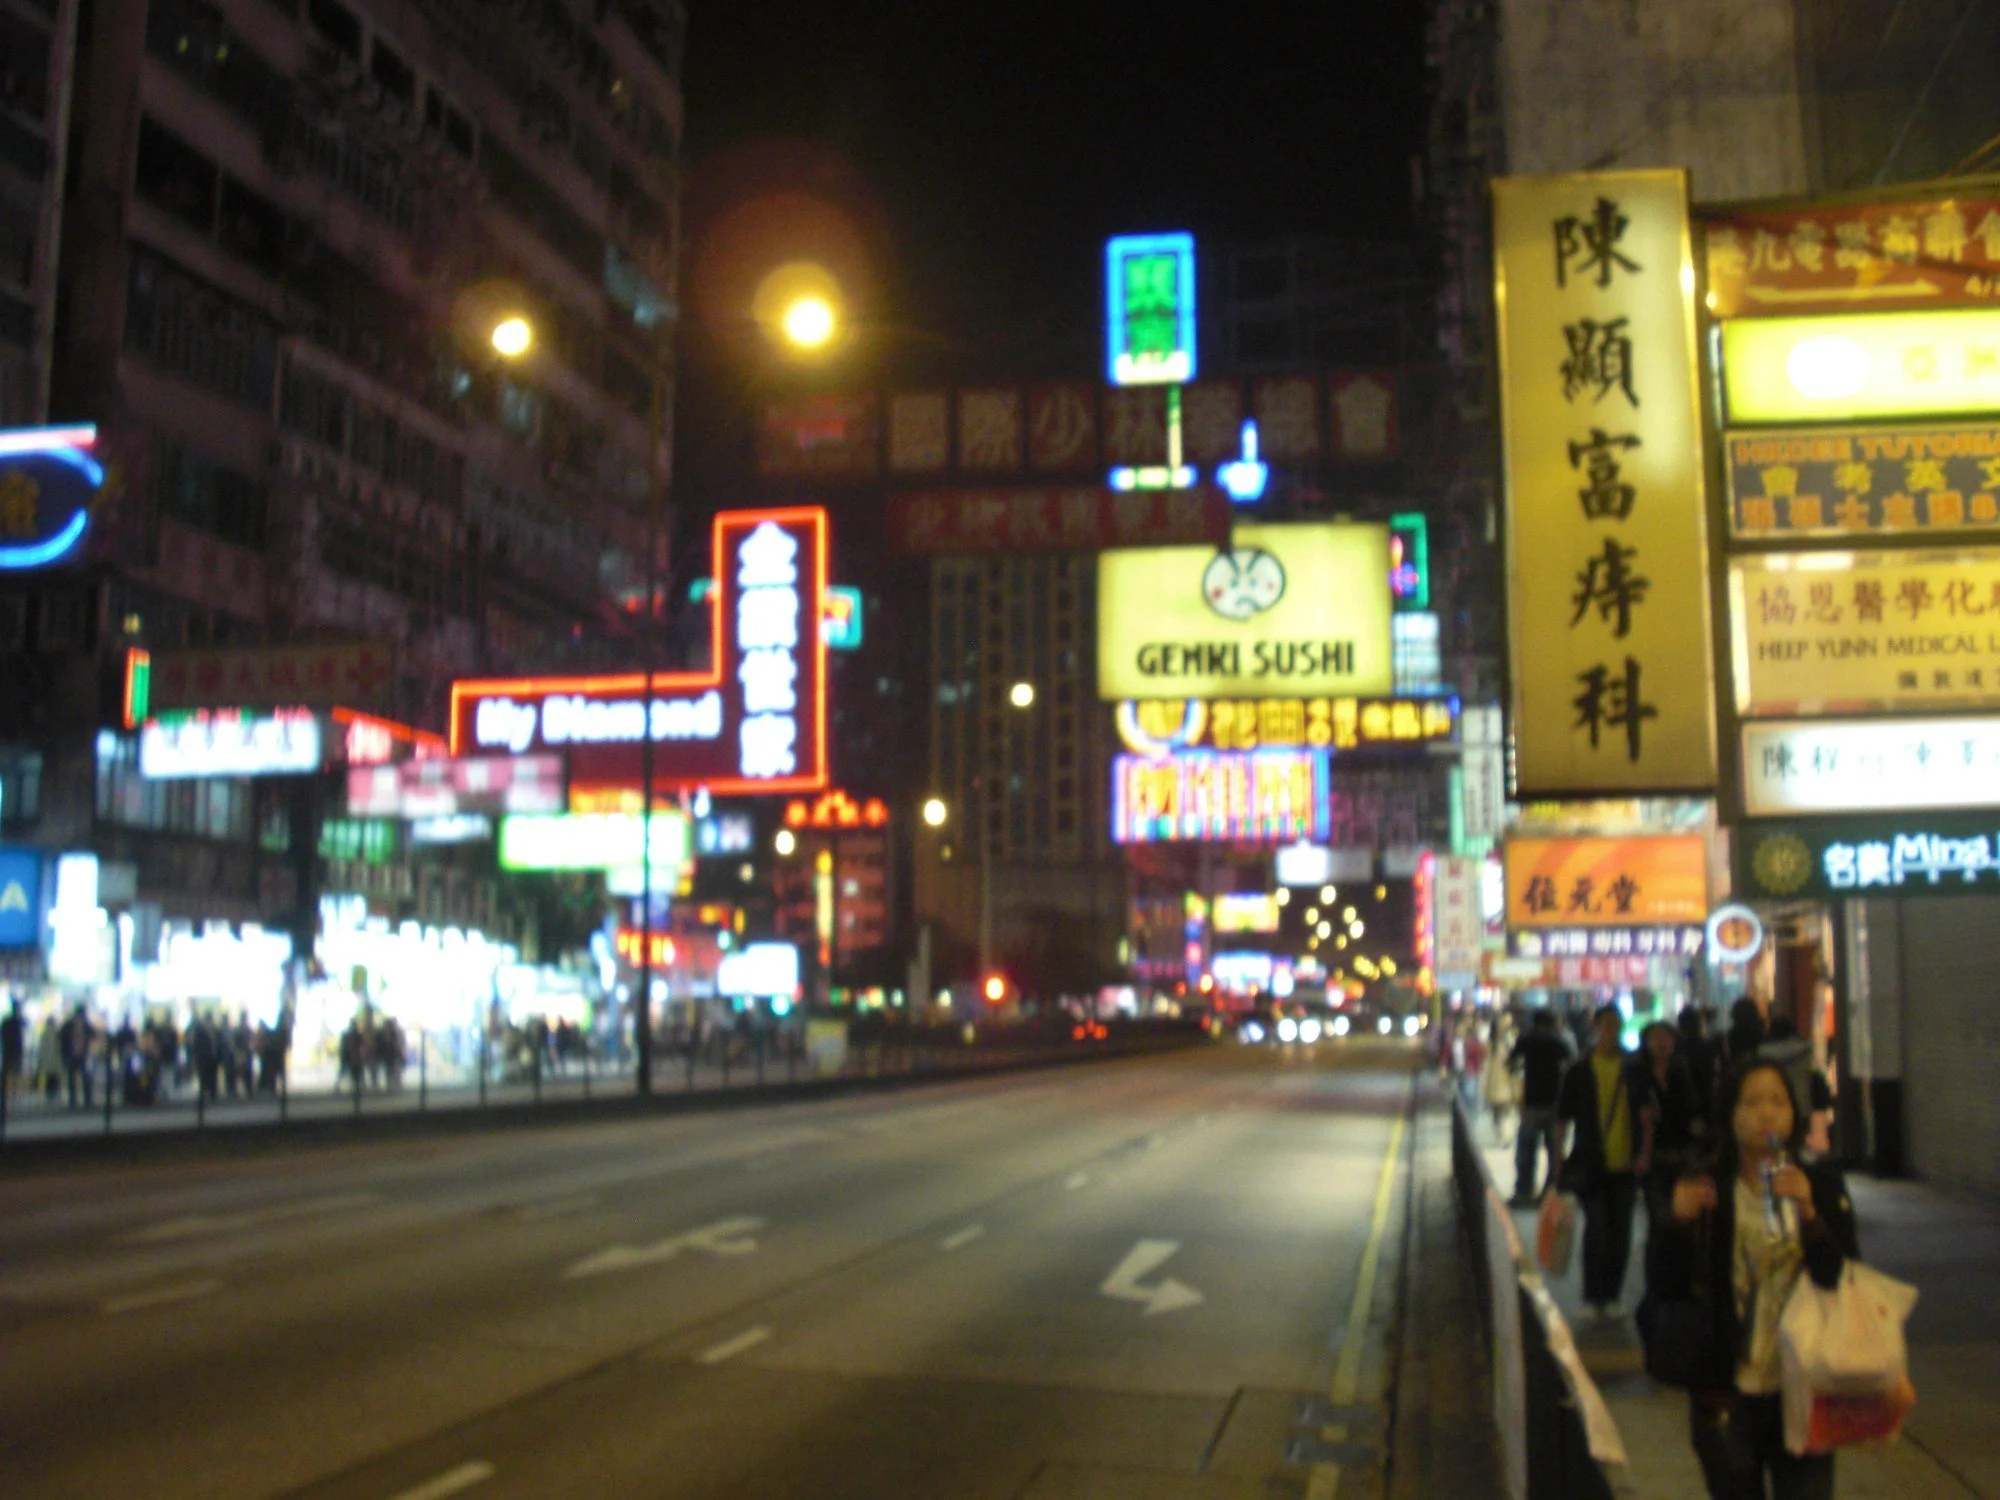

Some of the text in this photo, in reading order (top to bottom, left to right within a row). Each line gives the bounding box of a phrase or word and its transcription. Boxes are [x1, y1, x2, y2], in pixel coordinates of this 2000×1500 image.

[1758, 577, 2000, 625] 協恩醫學化
[1137, 640, 1355, 677] GENKI SUSHI
[1887, 634, 1979, 655] MEDICAL
[543, 690, 720, 742] Diamnd
